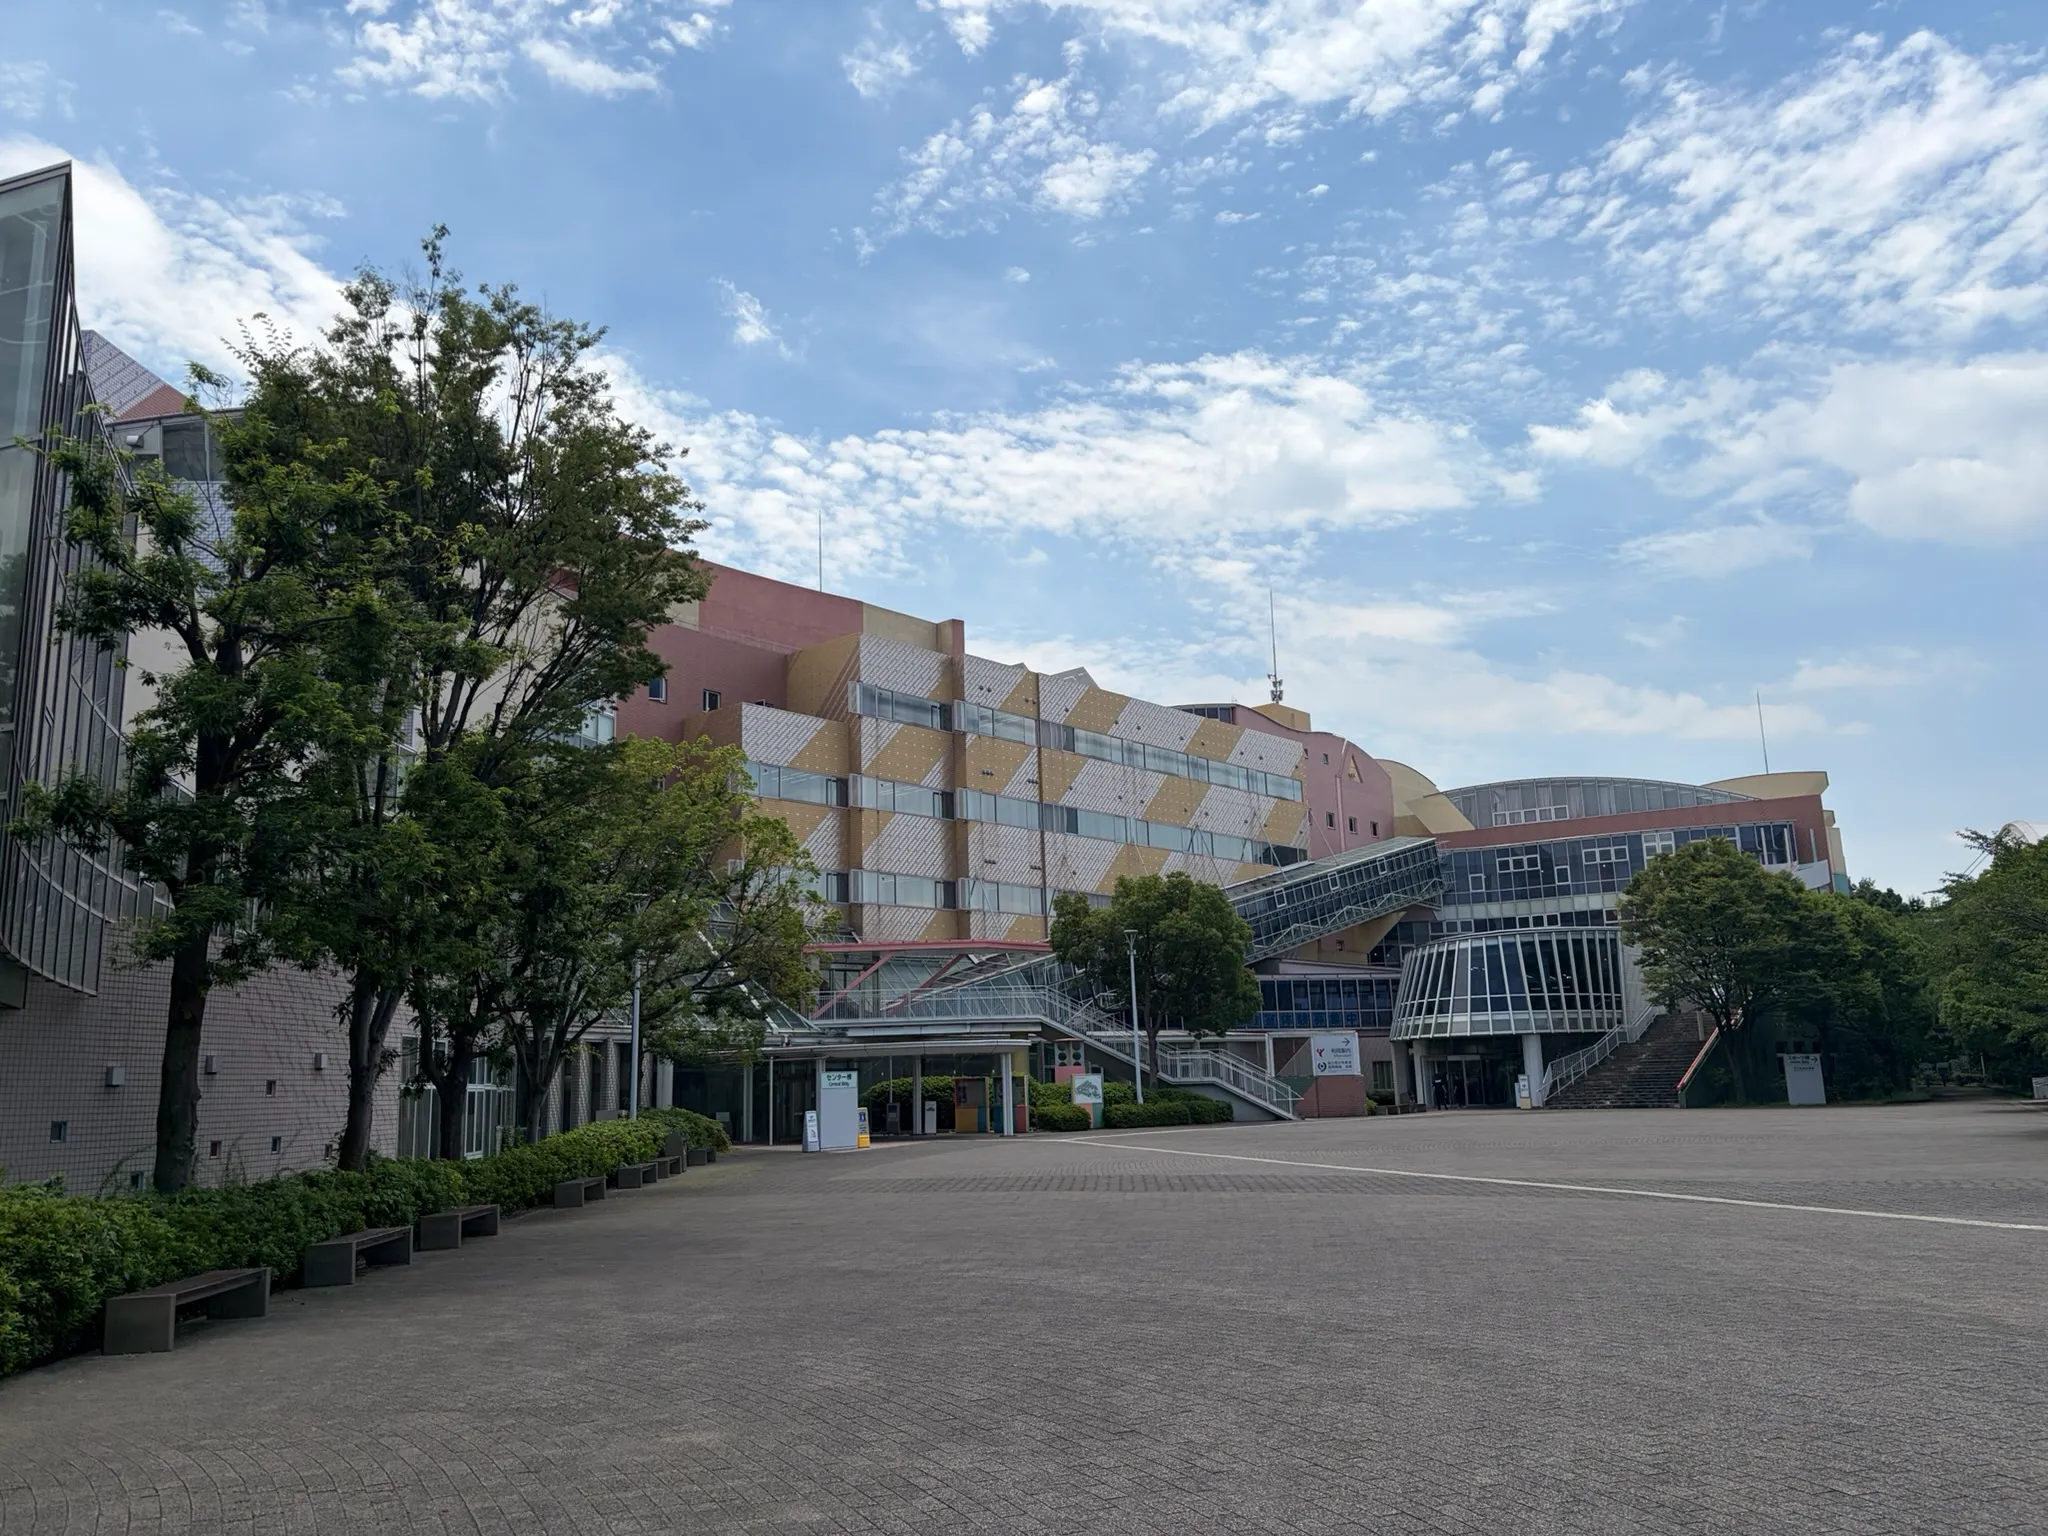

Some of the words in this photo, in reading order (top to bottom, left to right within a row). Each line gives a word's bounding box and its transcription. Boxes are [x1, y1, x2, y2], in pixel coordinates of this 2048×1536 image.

[826, 1073, 852, 1081] センター棟
